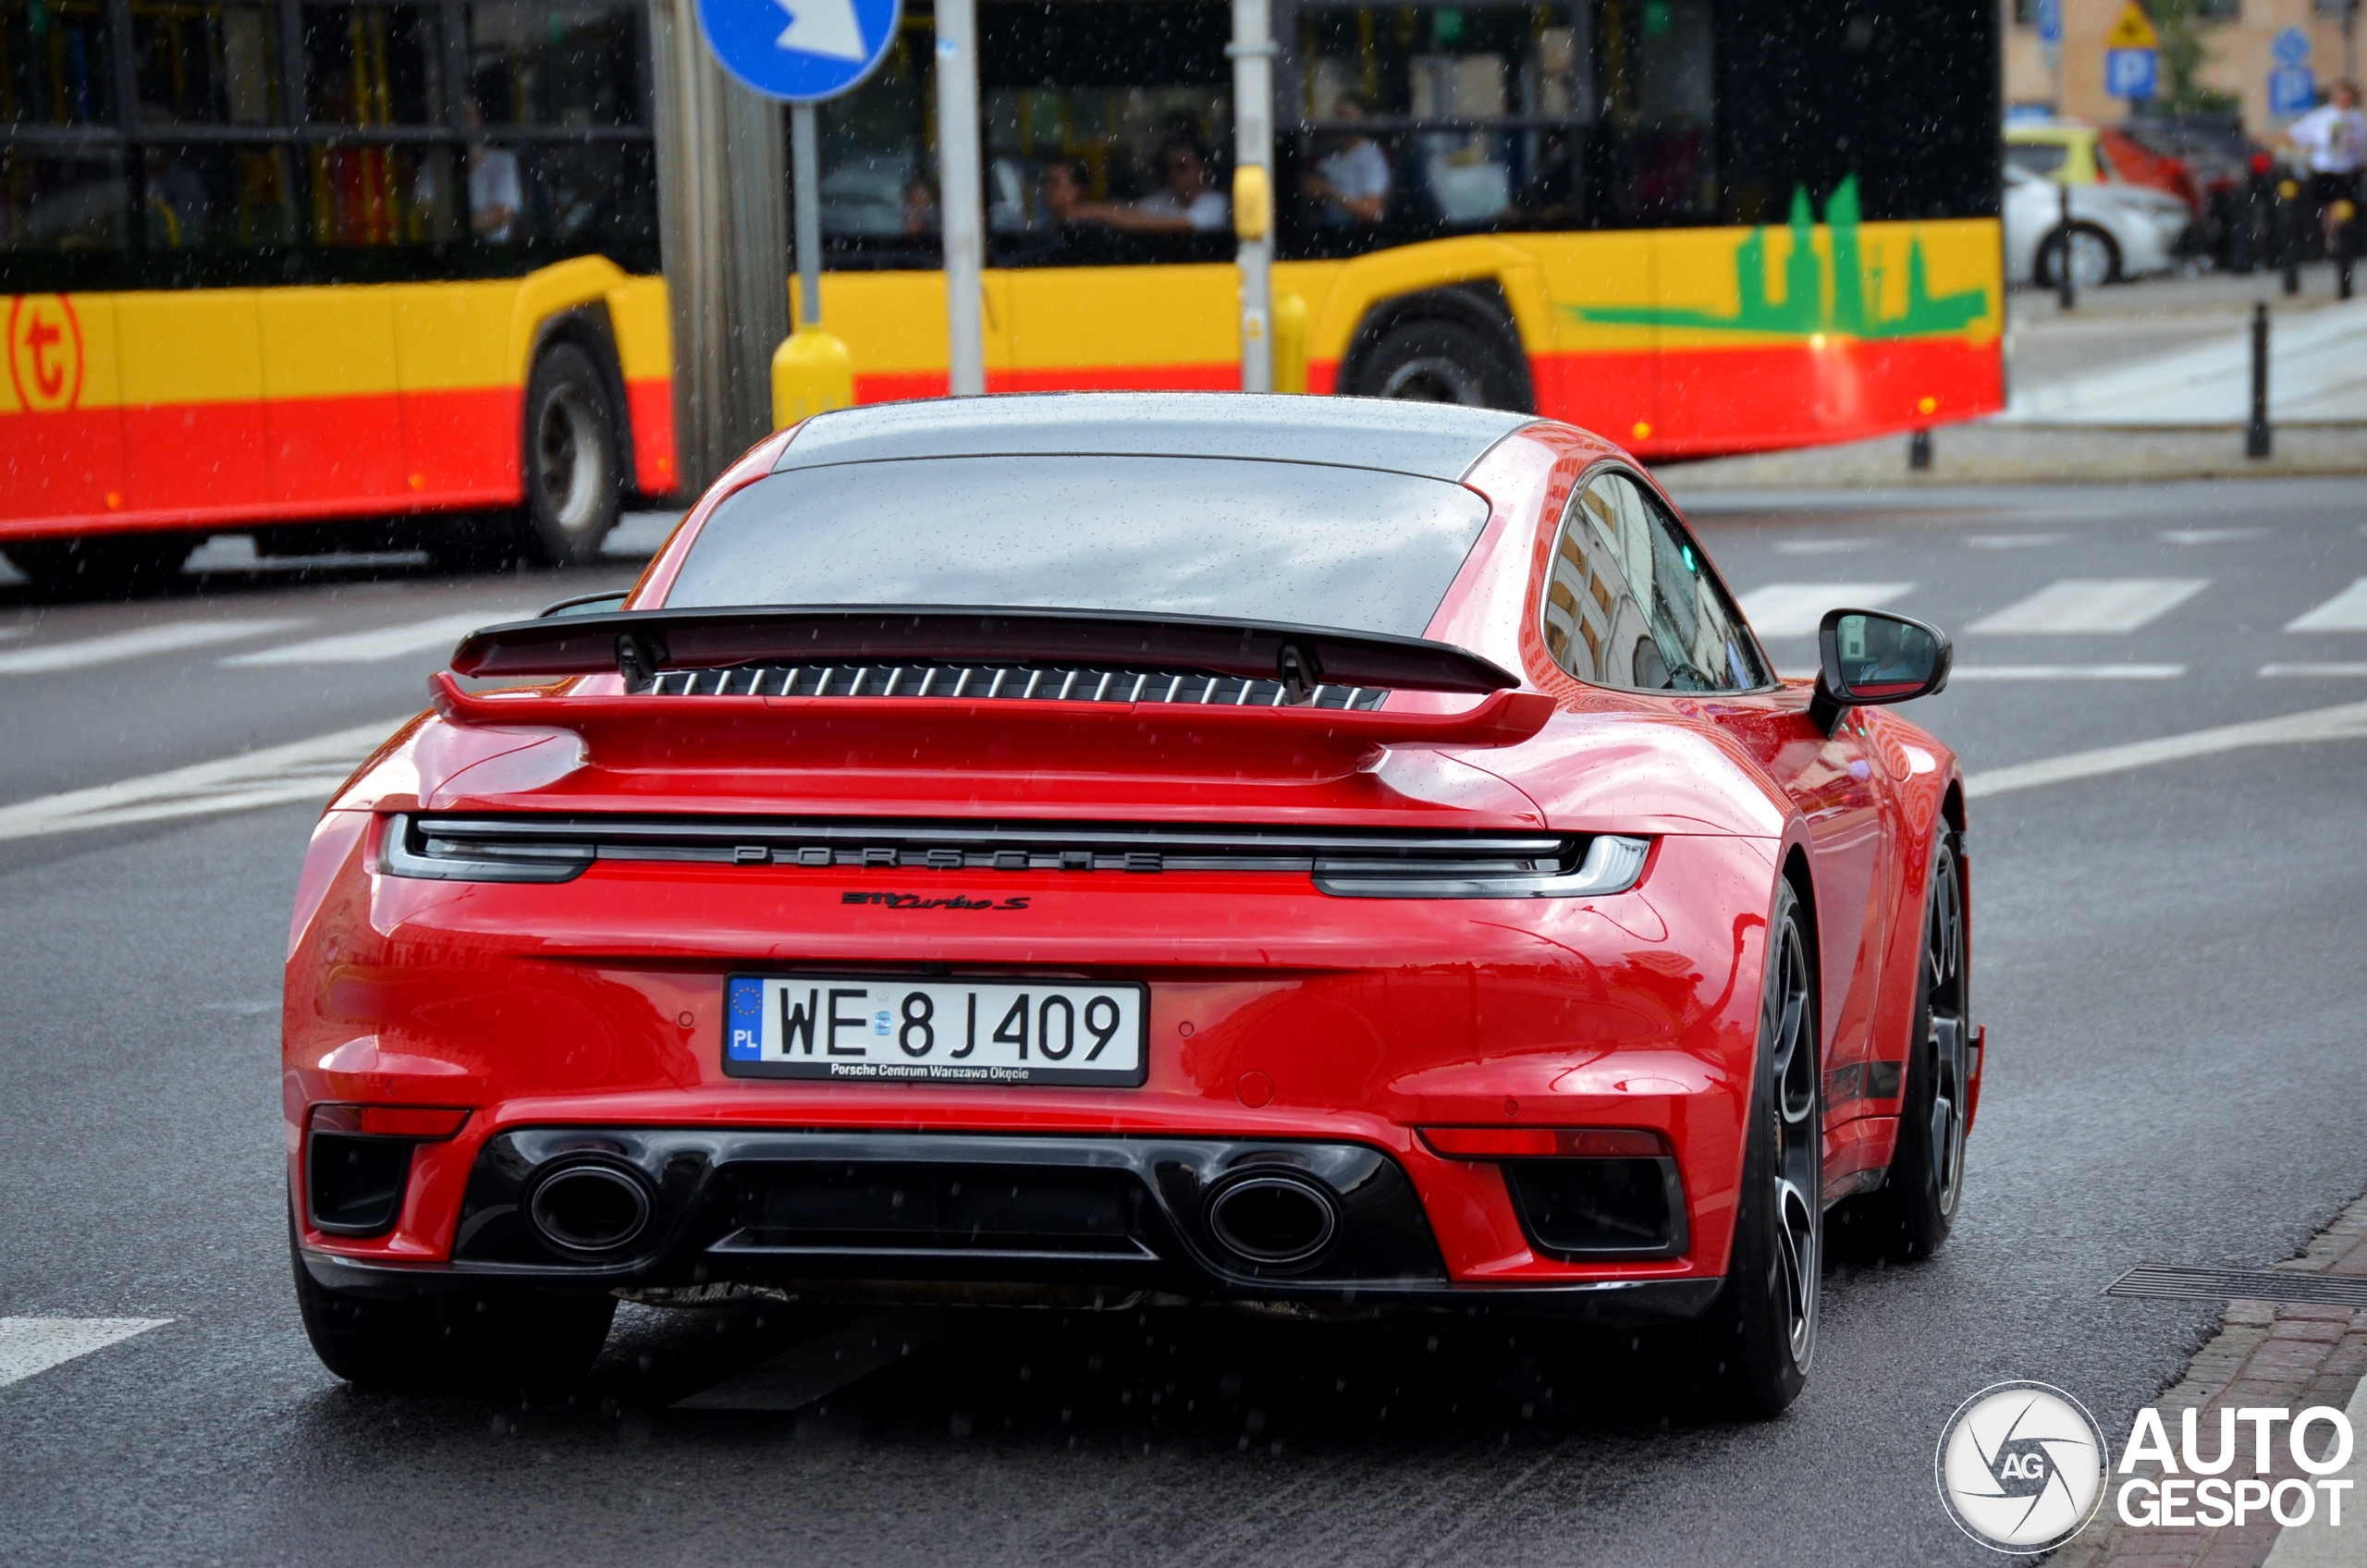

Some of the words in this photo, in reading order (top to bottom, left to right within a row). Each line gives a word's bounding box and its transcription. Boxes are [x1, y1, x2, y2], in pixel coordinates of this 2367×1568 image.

[733, 845, 1163, 872] PORSCHE
[992, 897, 1031, 910] S
[779, 987, 867, 1055] WE
[899, 991, 1121, 1060] 8J409
[733, 1030, 757, 1048] PL
[831, 1064, 877, 1076] Porsche
[878, 1065, 927, 1077] Centrum
[930, 1066, 987, 1079] Warszawa
[989, 1067, 1029, 1082] Okęcie
